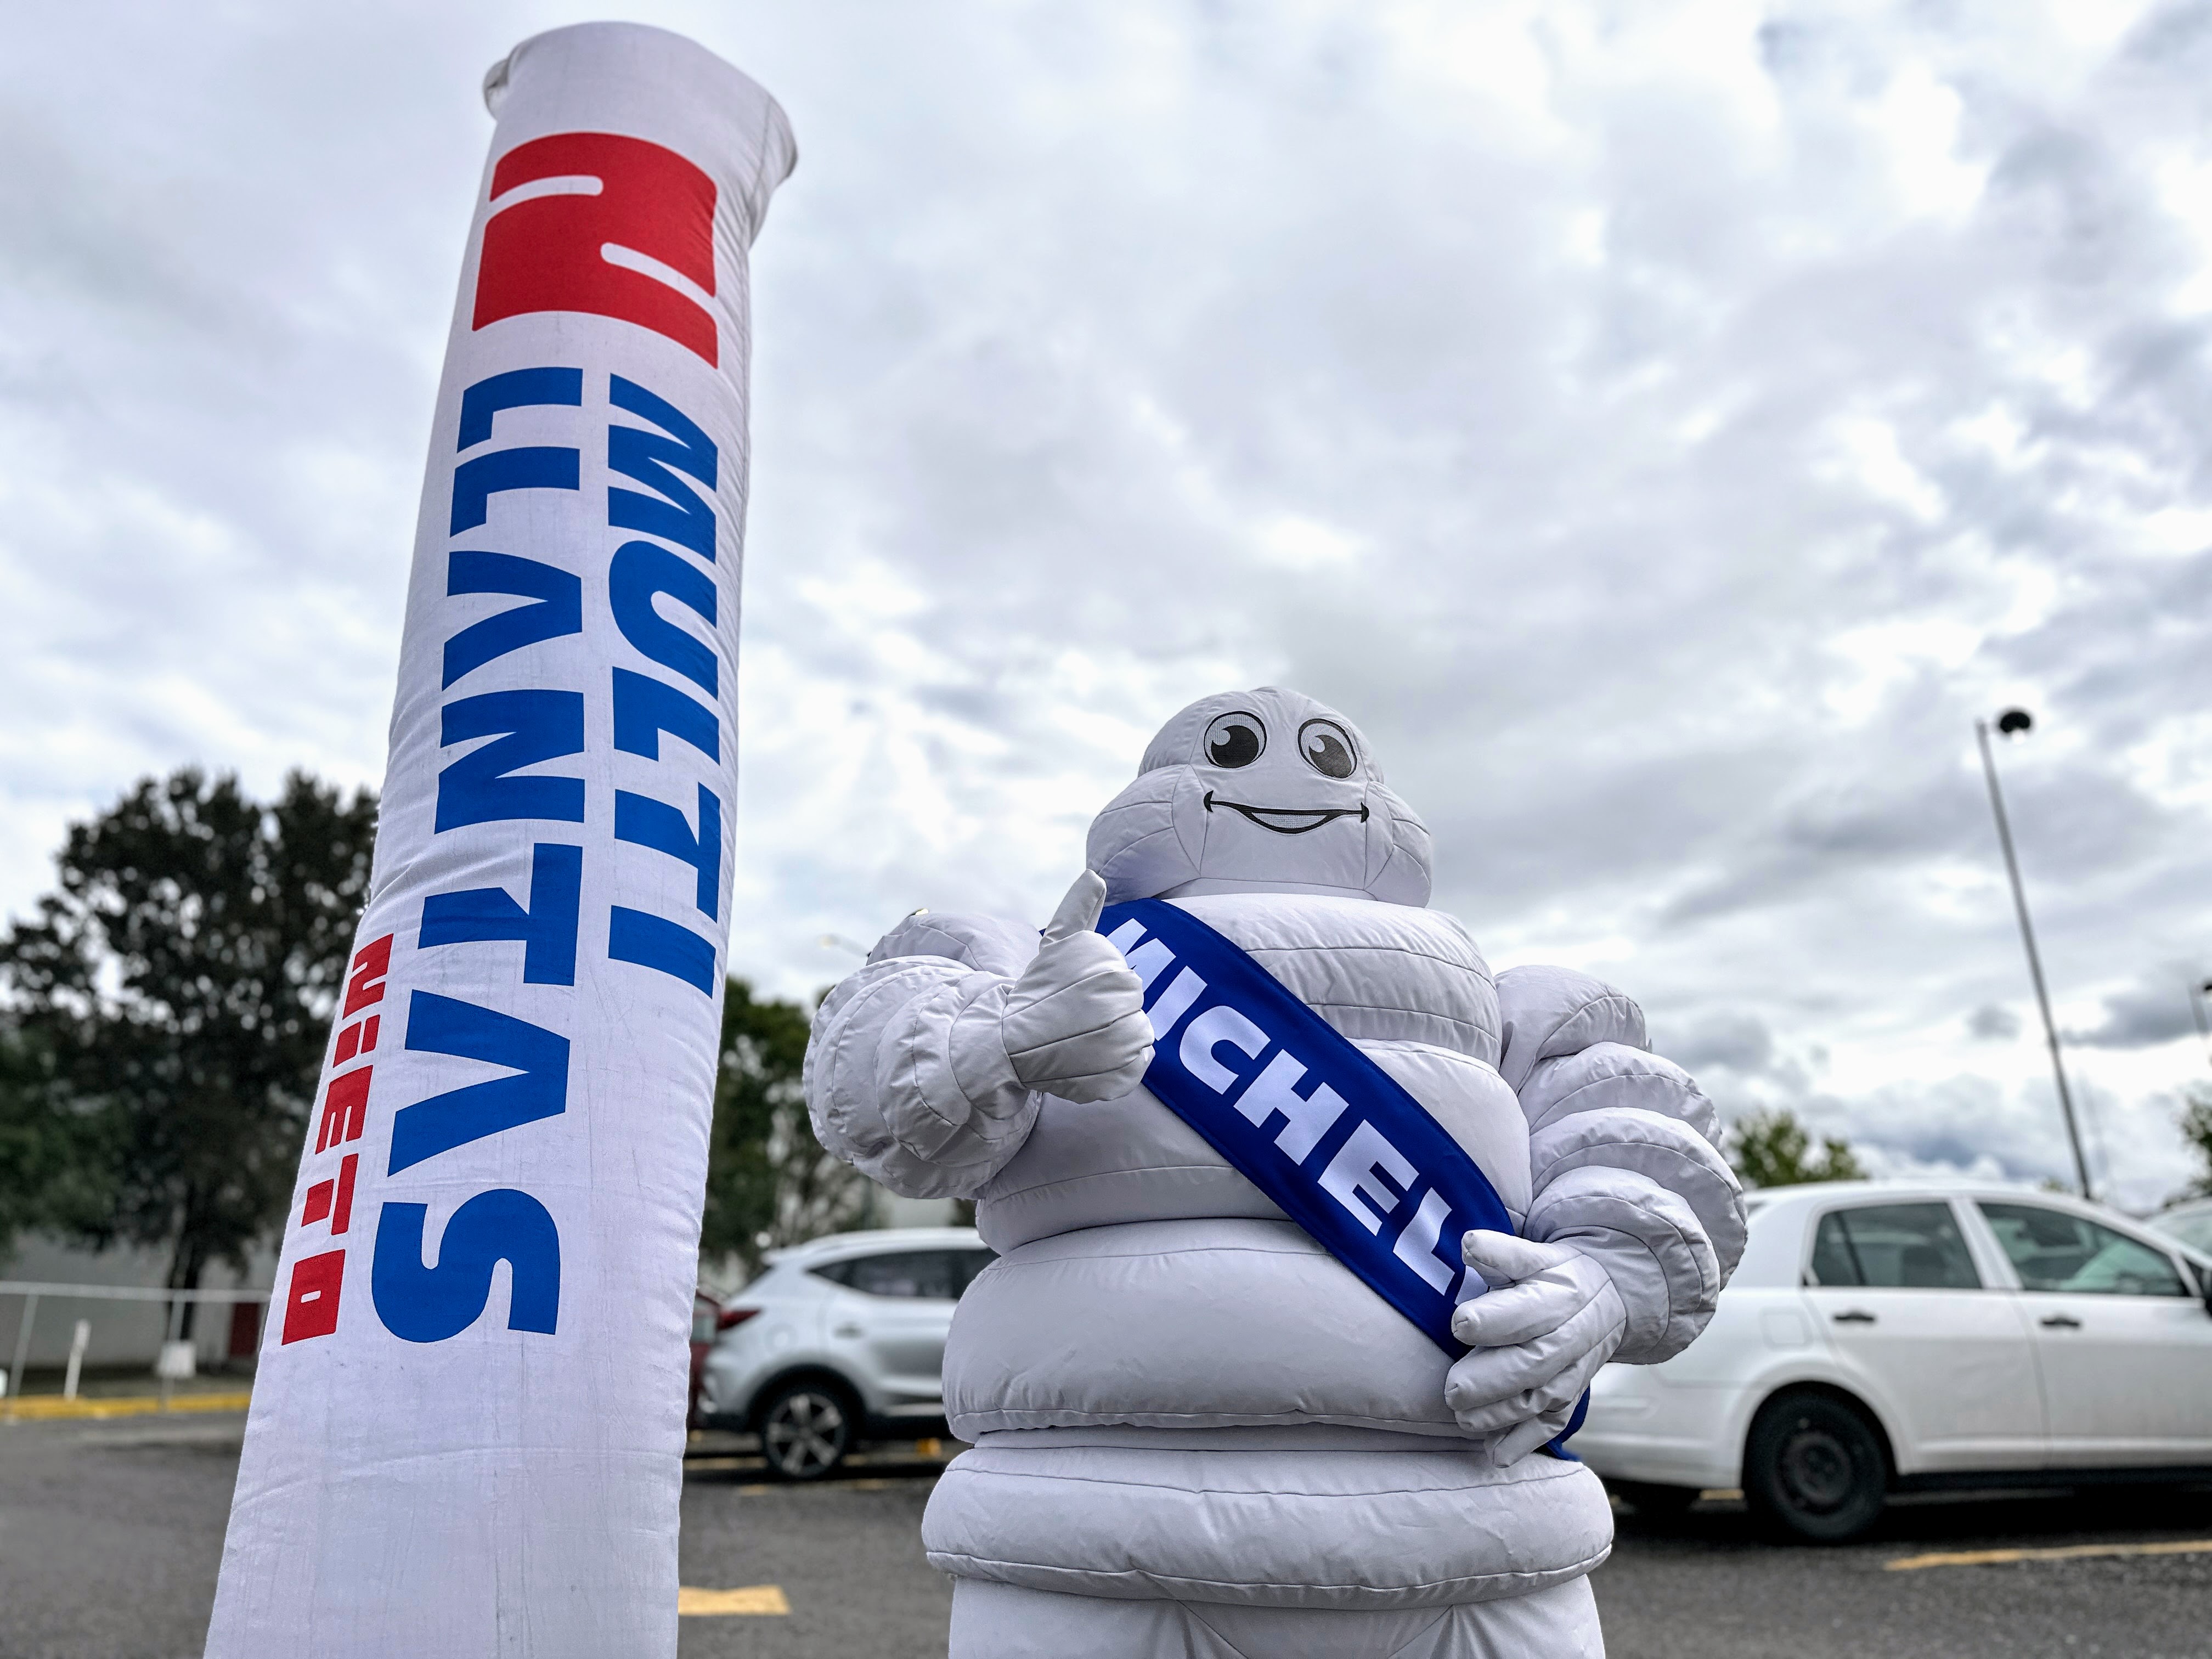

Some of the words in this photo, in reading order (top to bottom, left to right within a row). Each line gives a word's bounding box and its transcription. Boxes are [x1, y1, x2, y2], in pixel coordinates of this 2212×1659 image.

[371, 367, 585, 1343] LLANTAS
[608, 375, 721, 997] MULTI
[282, 934, 393, 1344] NIETO
